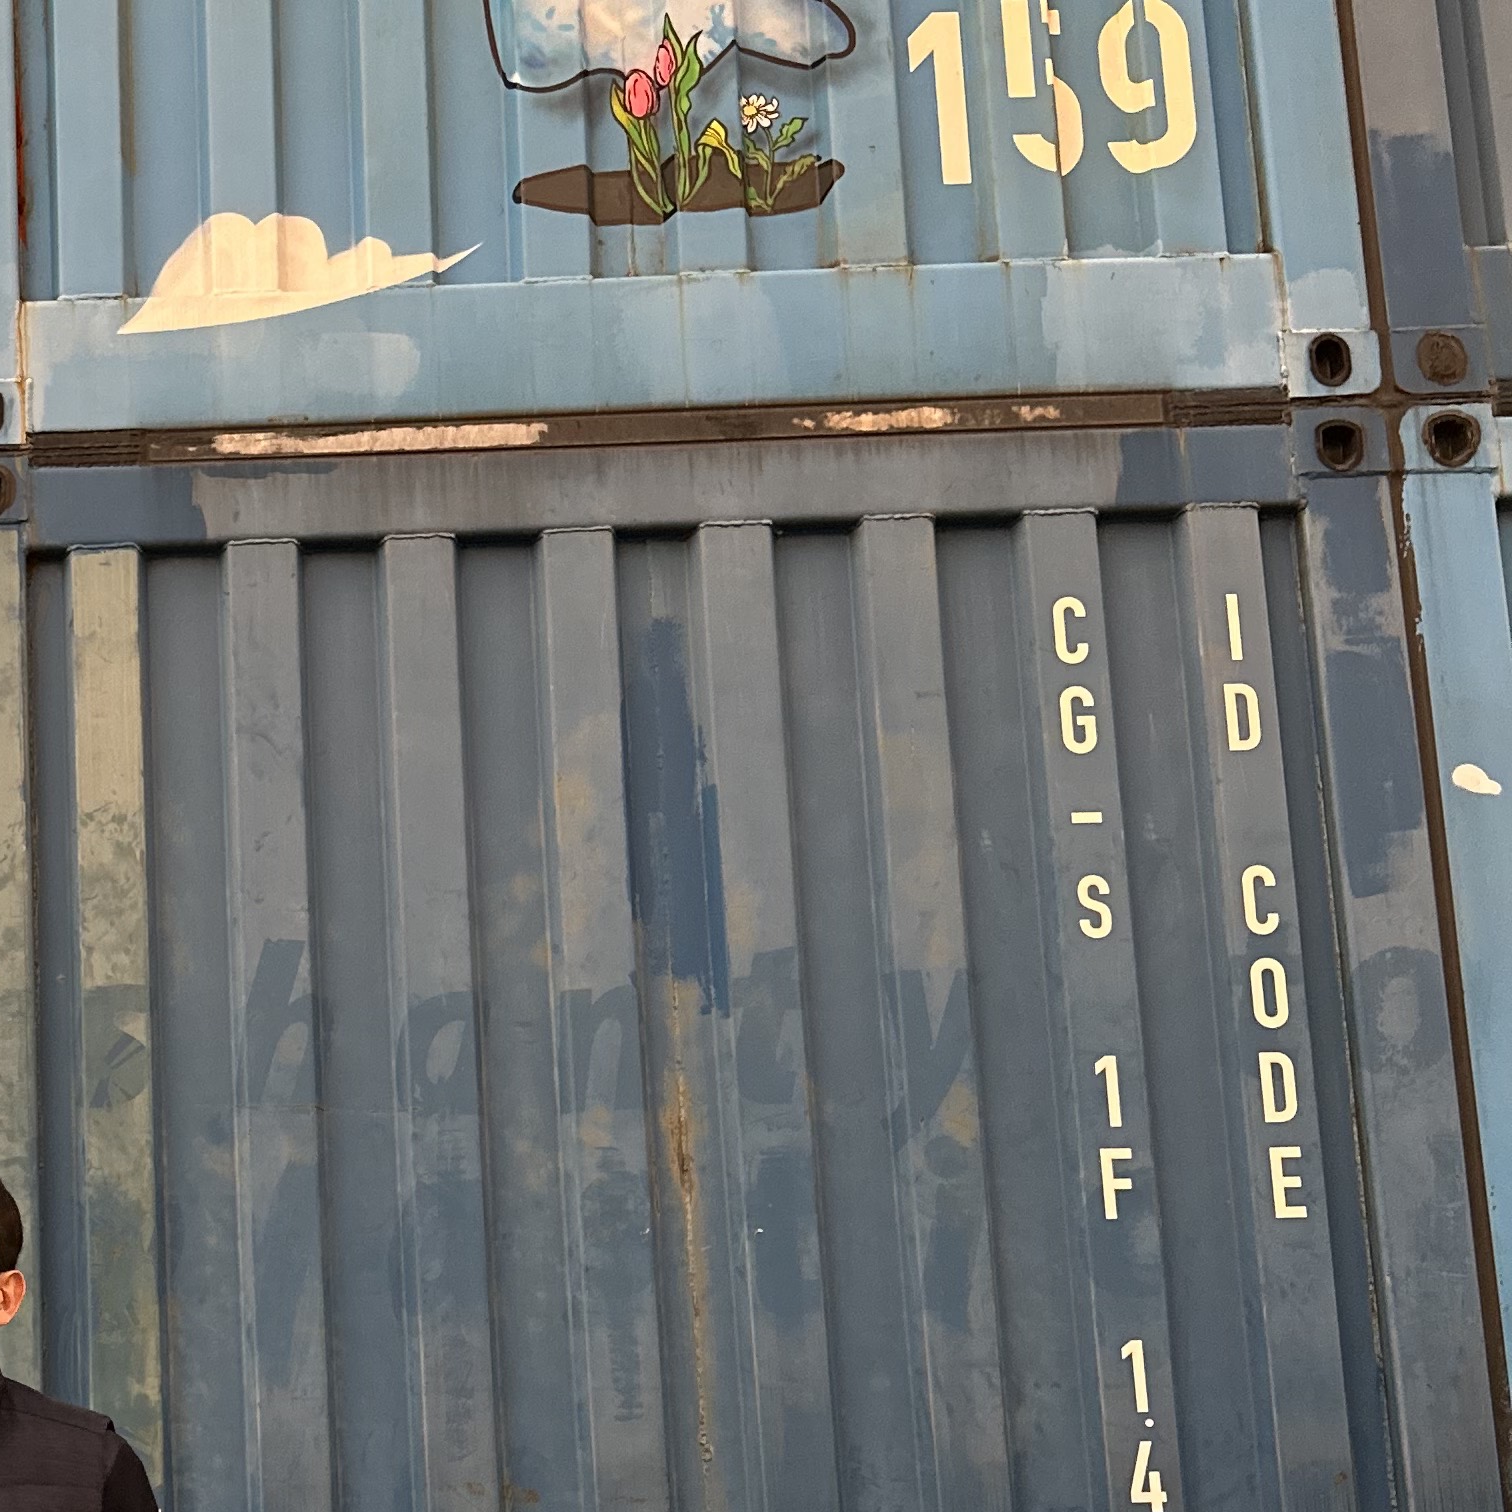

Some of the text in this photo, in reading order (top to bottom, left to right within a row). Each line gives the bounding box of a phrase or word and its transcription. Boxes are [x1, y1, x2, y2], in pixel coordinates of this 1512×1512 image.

[907, 0, 1198, 186] 159
[1052, 596, 1113, 940] CG-S
[1094, 1055, 1133, 1220] 1F
[1223, 593, 1308, 1220] ID CODE
